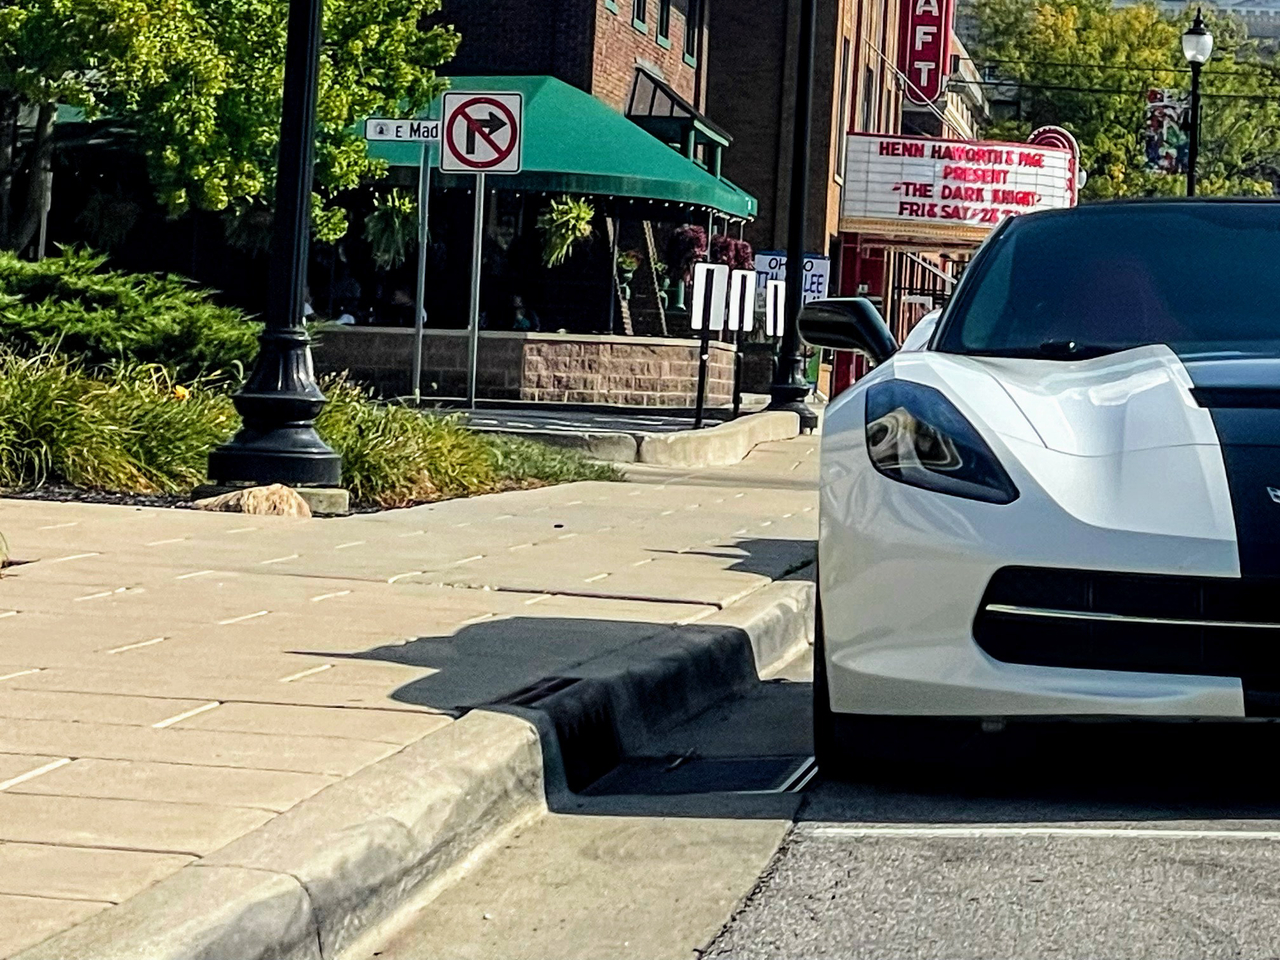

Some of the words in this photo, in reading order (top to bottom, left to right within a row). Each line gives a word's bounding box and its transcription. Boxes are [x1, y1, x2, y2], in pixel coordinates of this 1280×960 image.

[395, 125, 403, 138] E
[409, 122, 439, 138] Mad
[879, 141, 925, 158] HENN
[943, 164, 1009, 184] PRESENT
[941, 184, 984, 202] DARK
[768, 257, 814, 272] OHO
[803, 273, 824, 293] LEE
